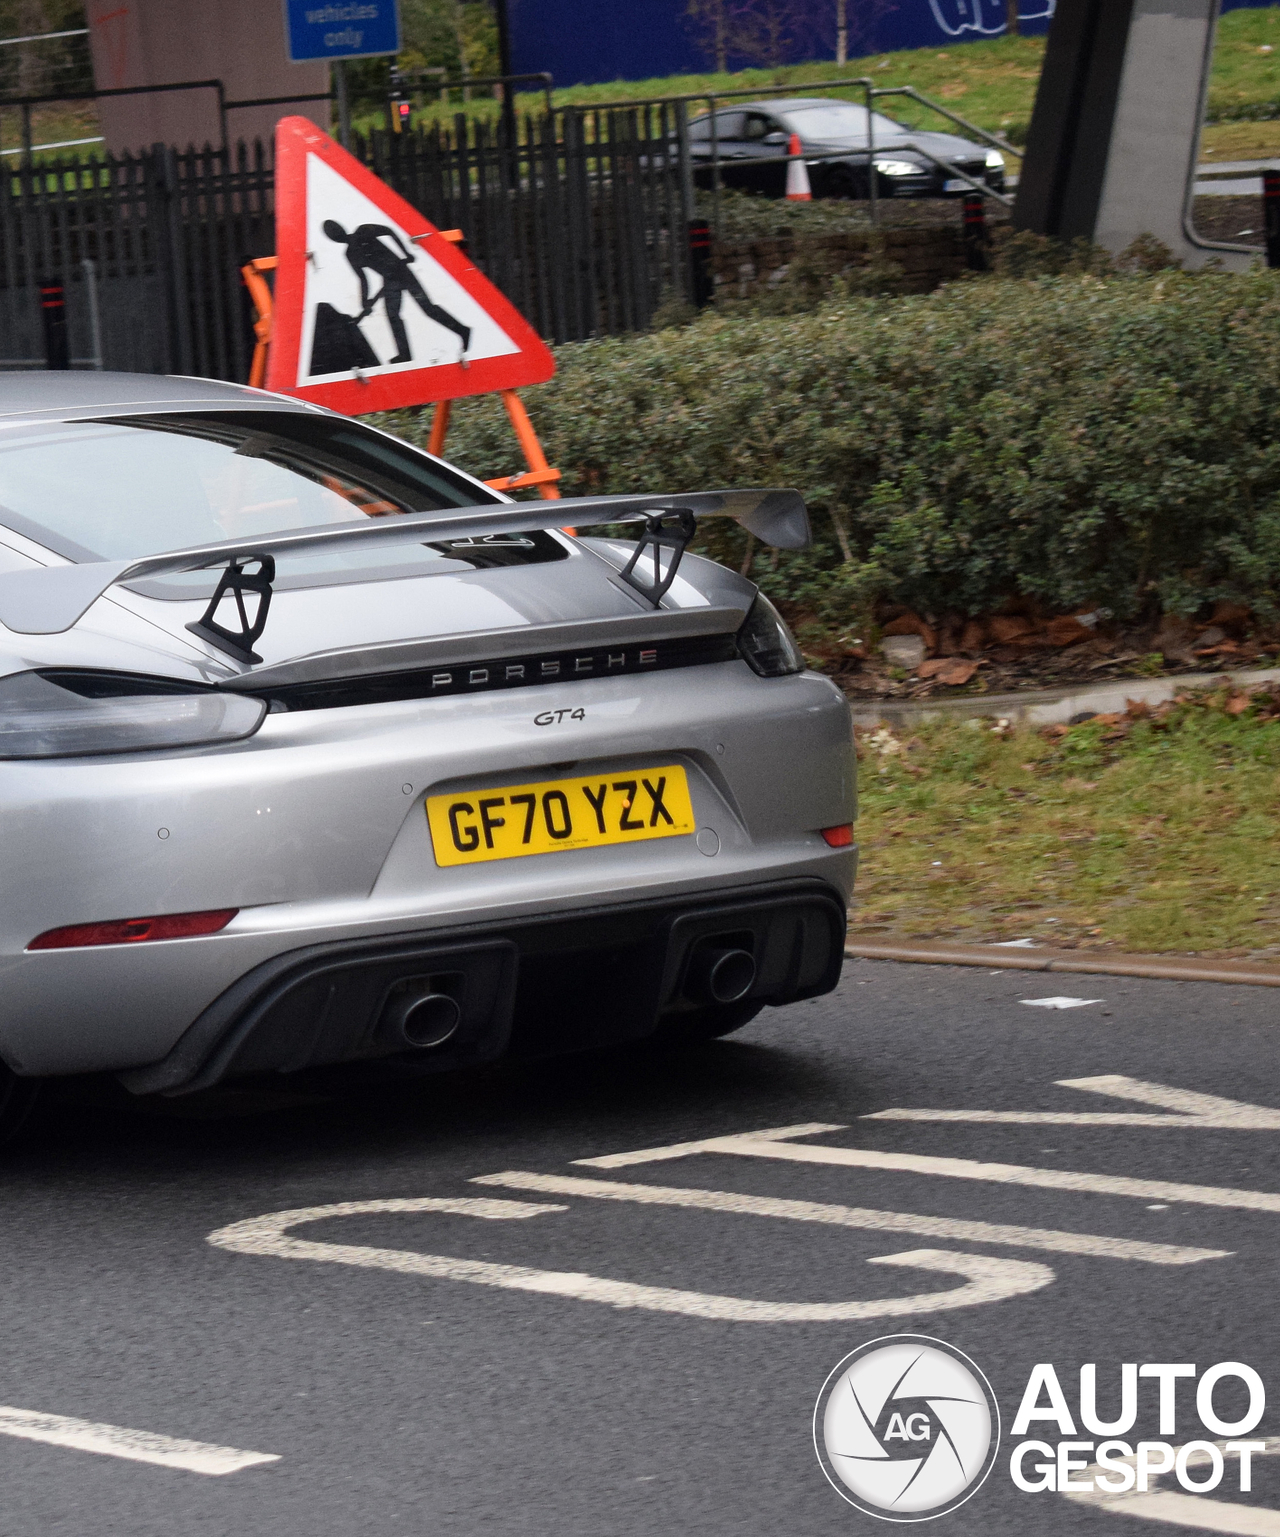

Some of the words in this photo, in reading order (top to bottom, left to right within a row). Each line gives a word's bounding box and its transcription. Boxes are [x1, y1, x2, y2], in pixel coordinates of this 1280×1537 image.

[305, 1, 379, 24] vehicles
[323, 26, 365, 48] only
[432, 649, 658, 689] PORSCHE
[533, 707, 586, 726] GT4
[448, 789, 573, 853] GF70
[582, 776, 674, 834] YZX
